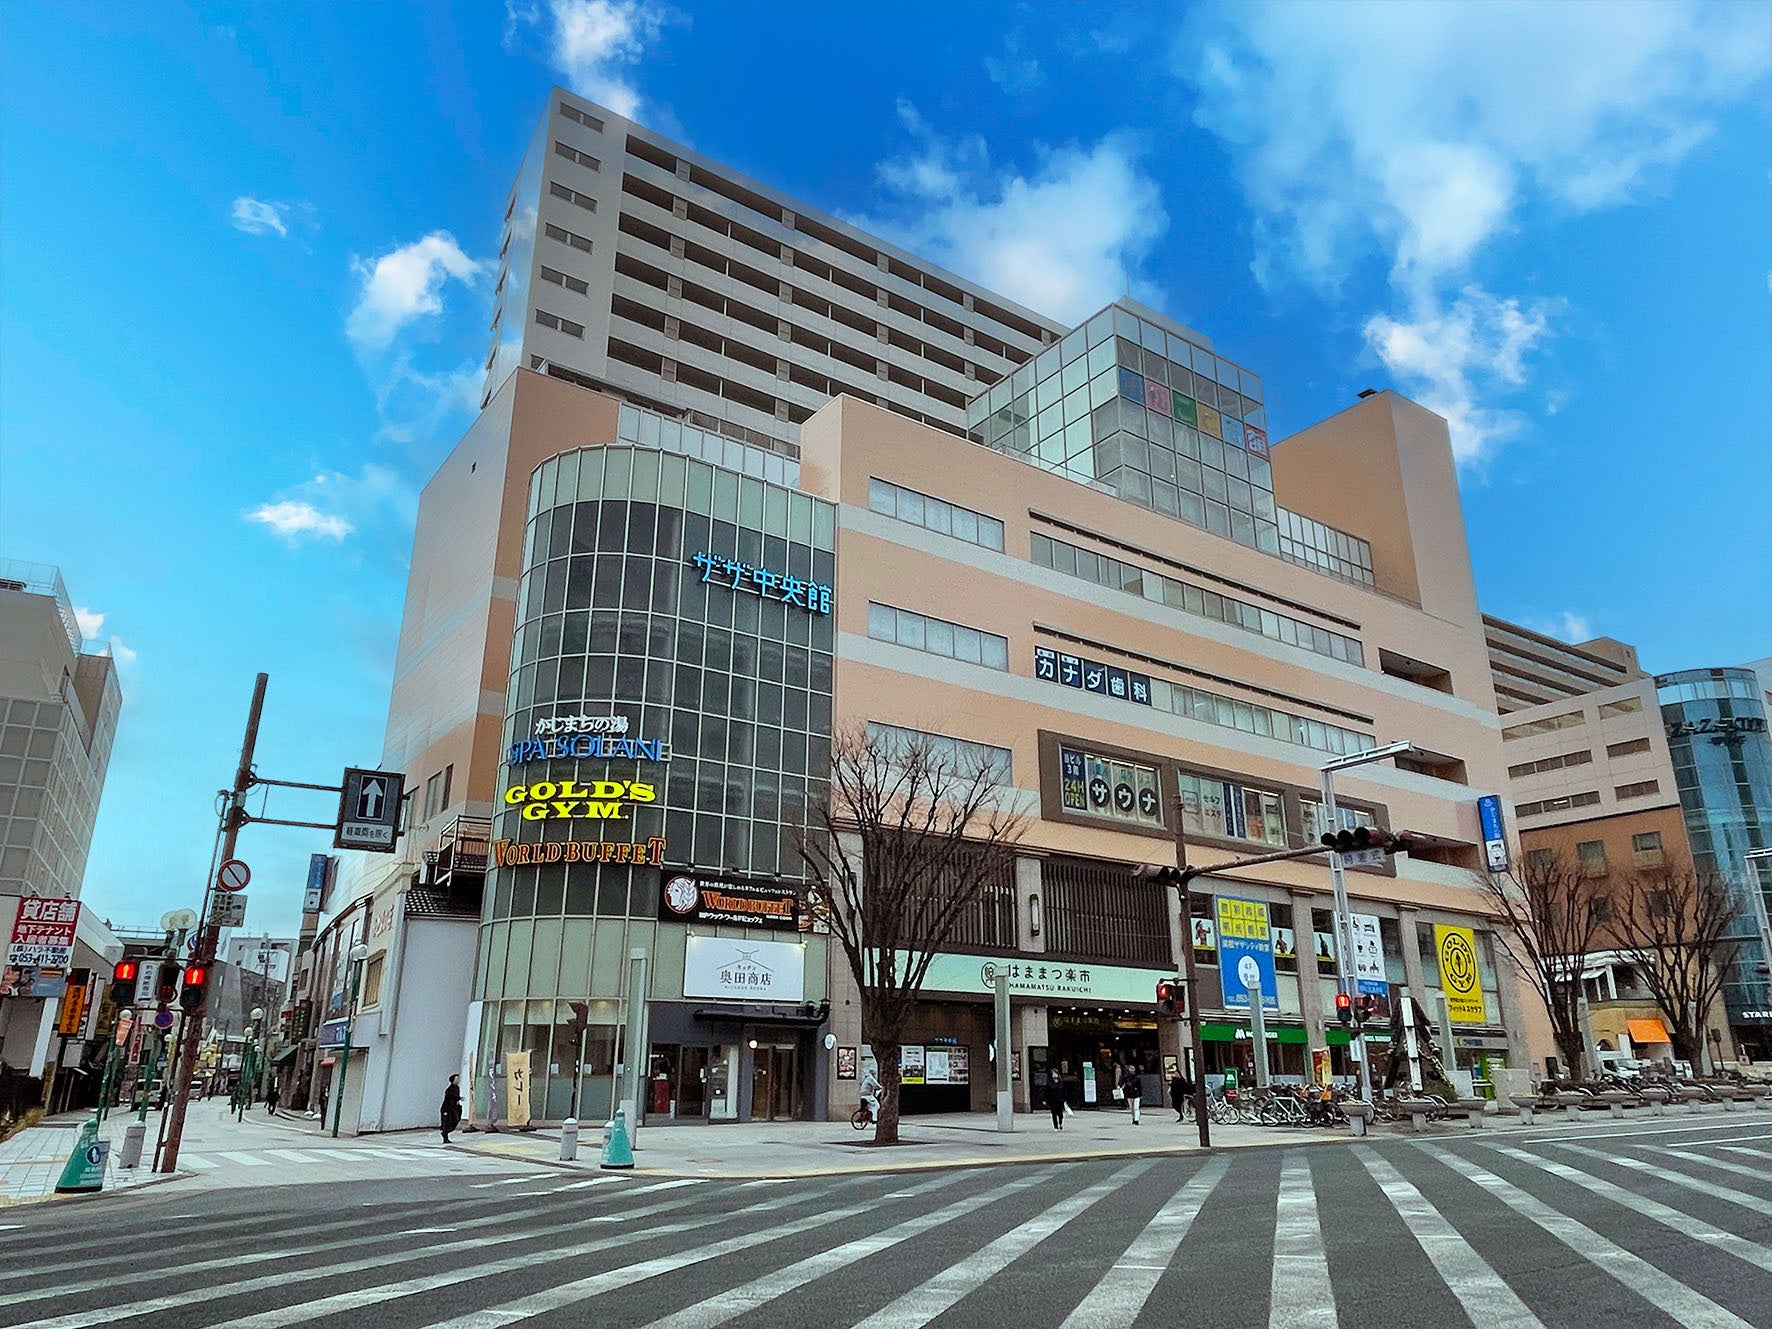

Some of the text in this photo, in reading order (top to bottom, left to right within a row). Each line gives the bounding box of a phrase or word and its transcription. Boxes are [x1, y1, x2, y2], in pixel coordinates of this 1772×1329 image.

[693, 551, 832, 614] ザザ中央館
[1039, 659, 1147, 702] カナダ歯科
[534, 714, 629, 735] かじまちの湯
[508, 732, 663, 766] SPA SOLANI
[504, 780, 656, 804] GOLD'S
[1064, 778, 1085, 794] 24H
[1091, 783, 1156, 812] サウナ
[1064, 792, 1086, 807] OPEN
[493, 837, 667, 867] WORLD BUFFET
[20, 898, 78, 922] 貸店舗
[701, 891, 793, 915] WORLD BUFFET
[17, 924, 72, 936] 地下テナント
[720, 970, 772, 985] 奥田商店
[1008, 964, 1091, 983] はままつ楽市
